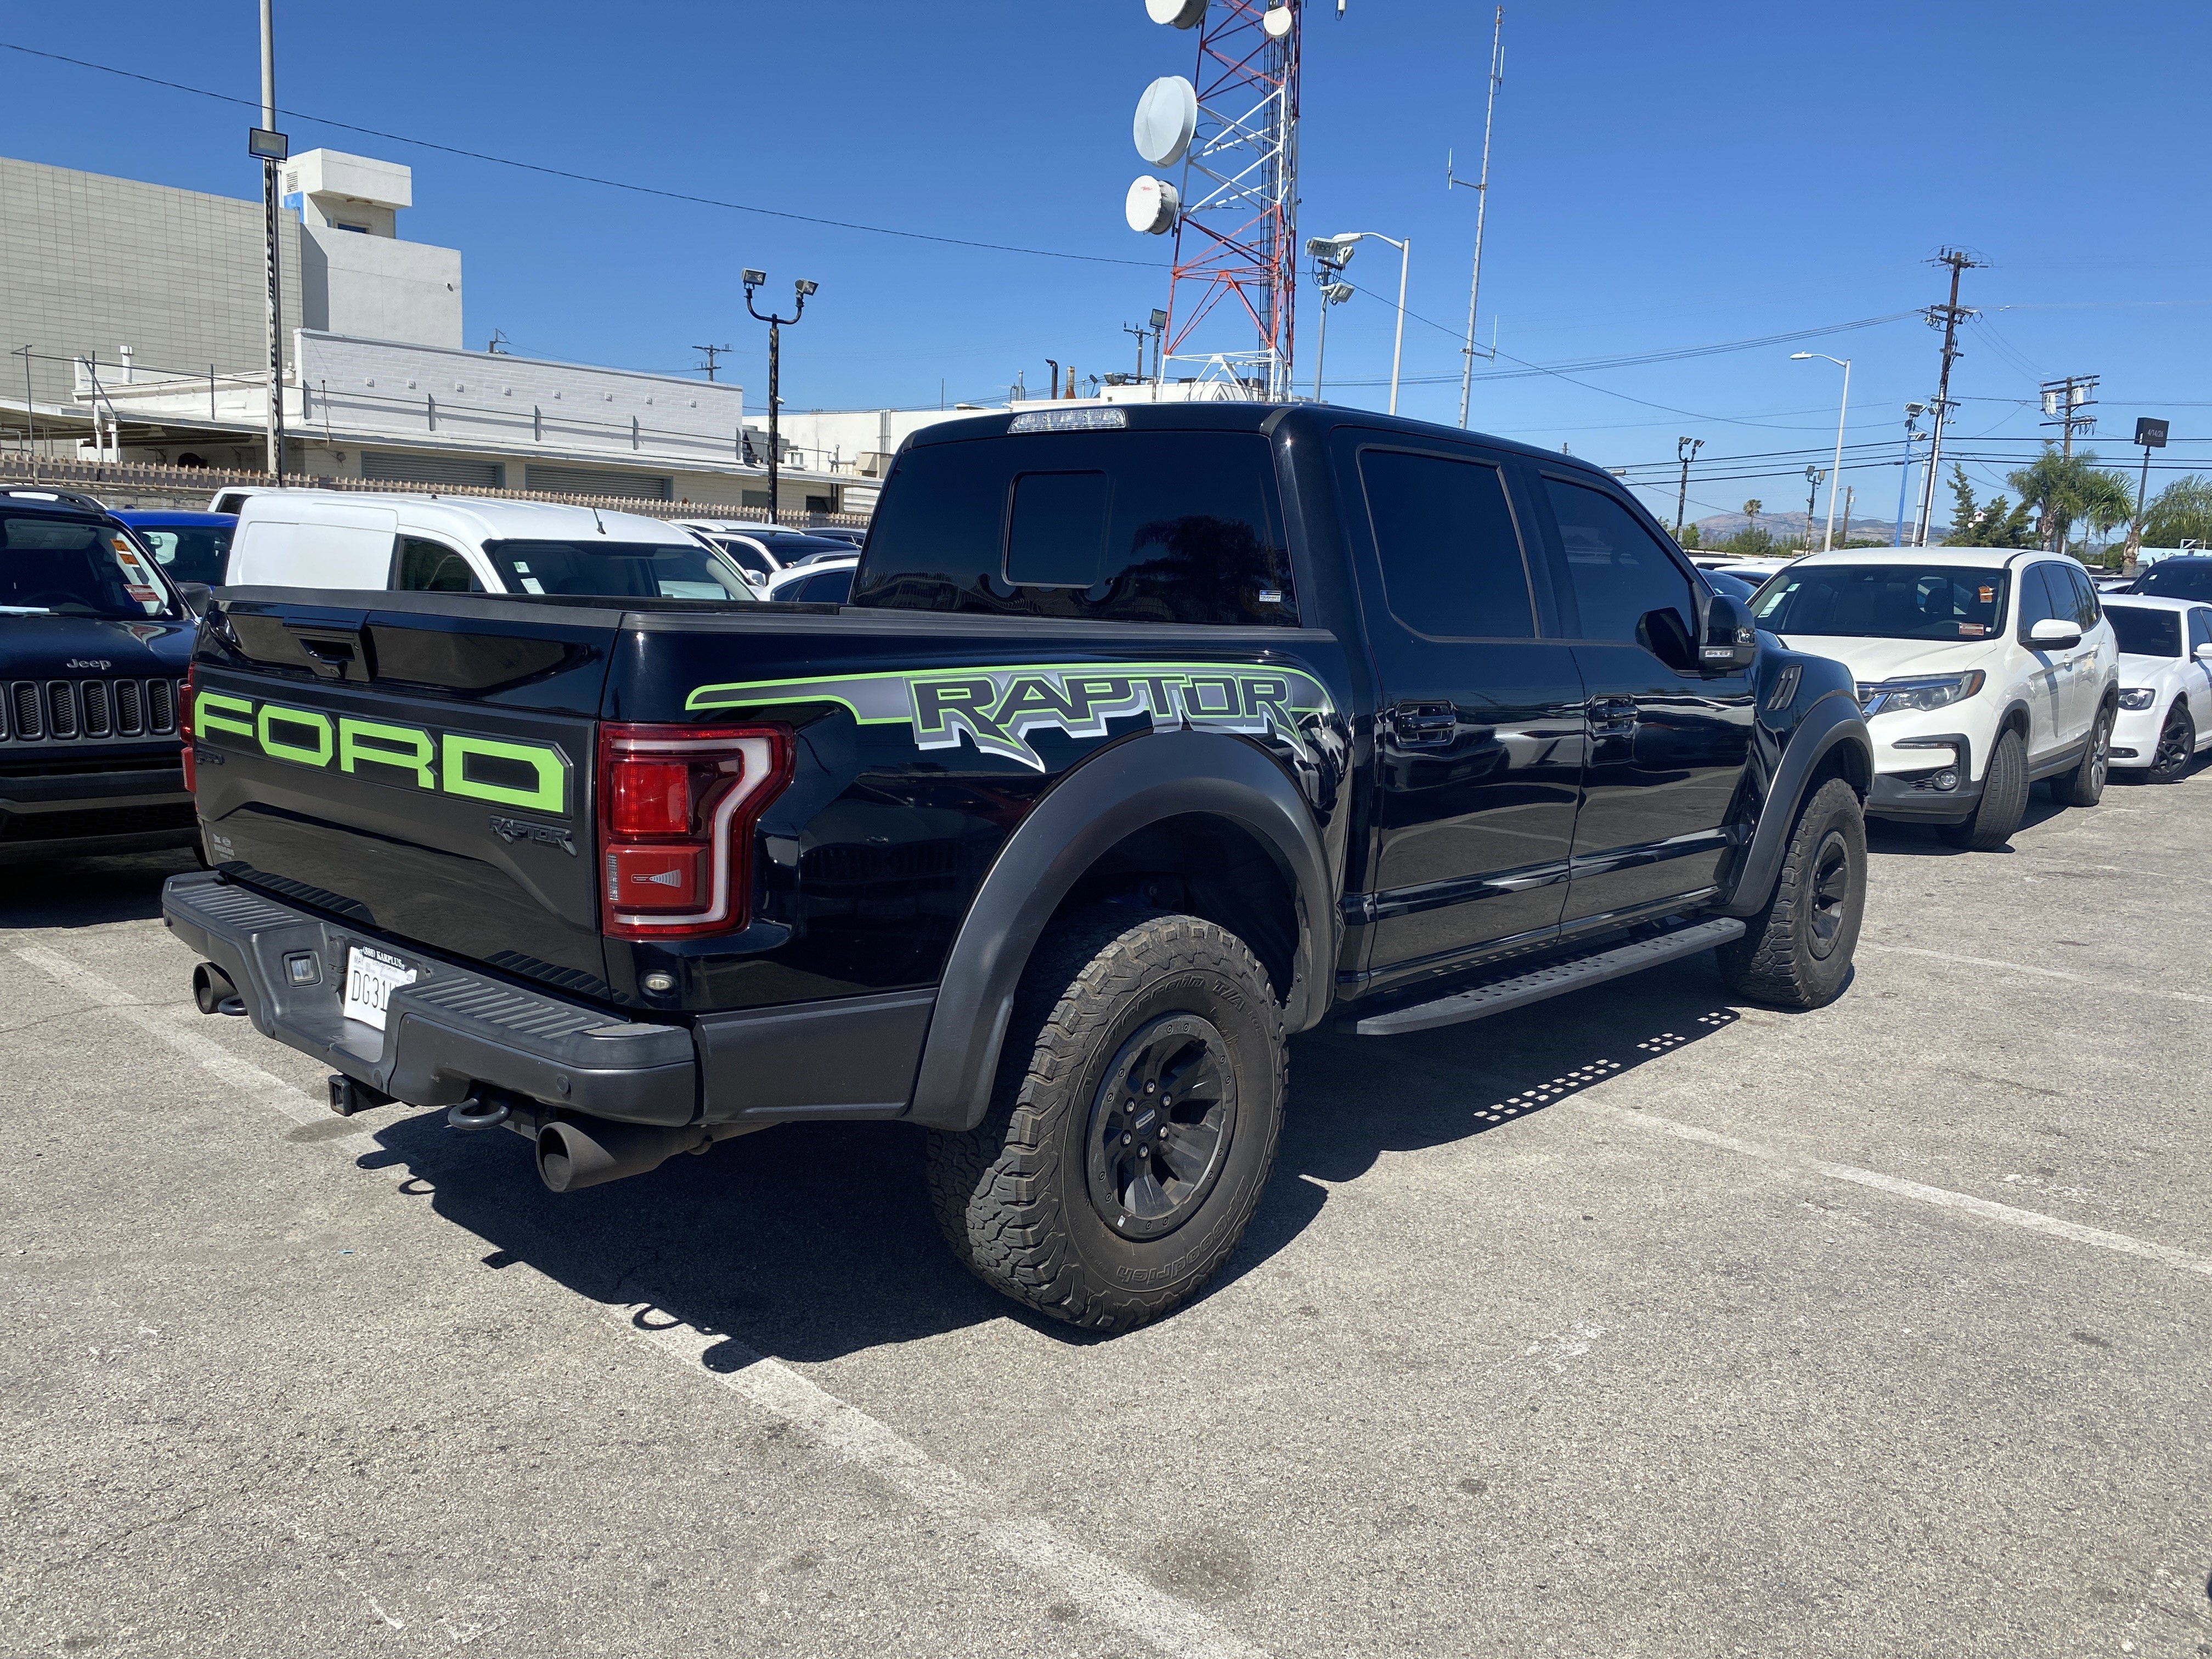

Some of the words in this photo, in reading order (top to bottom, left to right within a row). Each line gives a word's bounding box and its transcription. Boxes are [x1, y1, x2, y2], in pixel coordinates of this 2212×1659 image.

[66, 658, 111, 670] Jeep
[909, 674, 1306, 772] RAPTOR
[194, 691, 565, 814] FORD
[489, 815, 578, 856] RAPTOR
[363, 946, 376, 958] (888)
[376, 950, 403, 968] KARPLUS
[352, 970, 397, 1012] DG31
[1116, 1175, 1250, 1285] BFGoodrich
